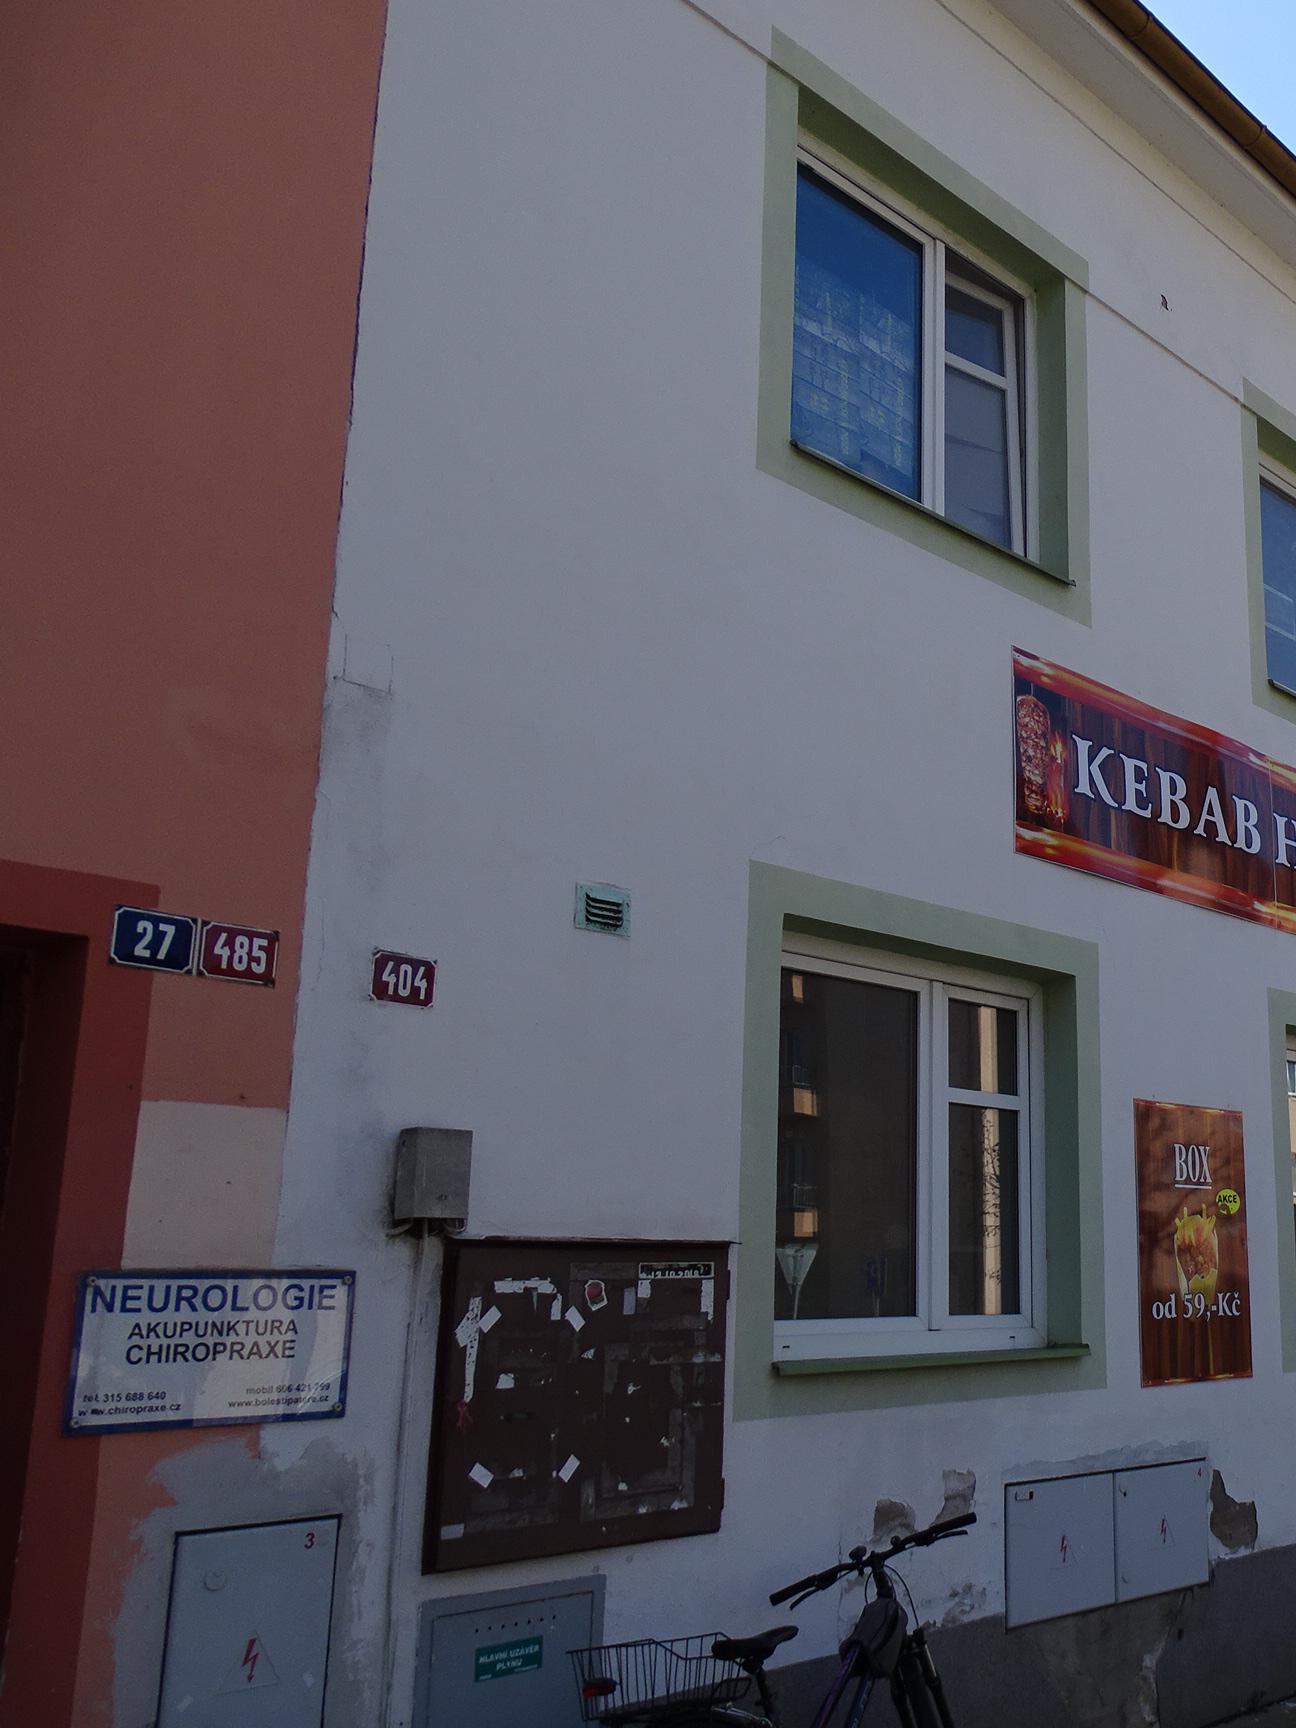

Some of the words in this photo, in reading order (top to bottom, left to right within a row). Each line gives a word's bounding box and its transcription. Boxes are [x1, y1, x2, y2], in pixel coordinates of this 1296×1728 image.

[1071, 734, 1262, 855] KEBAB
[134, 920, 176, 960] 27
[213, 932, 268, 975] 485
[381, 961, 428, 1000] 404
[1174, 1143, 1213, 1183] BOX
[1217, 1194, 1238, 1204] AKCE
[90, 1283, 338, 1314] NEUROLOGIE
[1152, 1294, 1177, 1319] od
[1182, 1292, 1242, 1322] 59,-Kč
[128, 1319, 298, 1340] AKUPUNKTURA
[125, 1339, 297, 1366] CHIROPRAXE
[103, 1392, 122, 1403] 315
[147, 1390, 167, 1401] 640
[304, 1532, 315, 1549] 3
